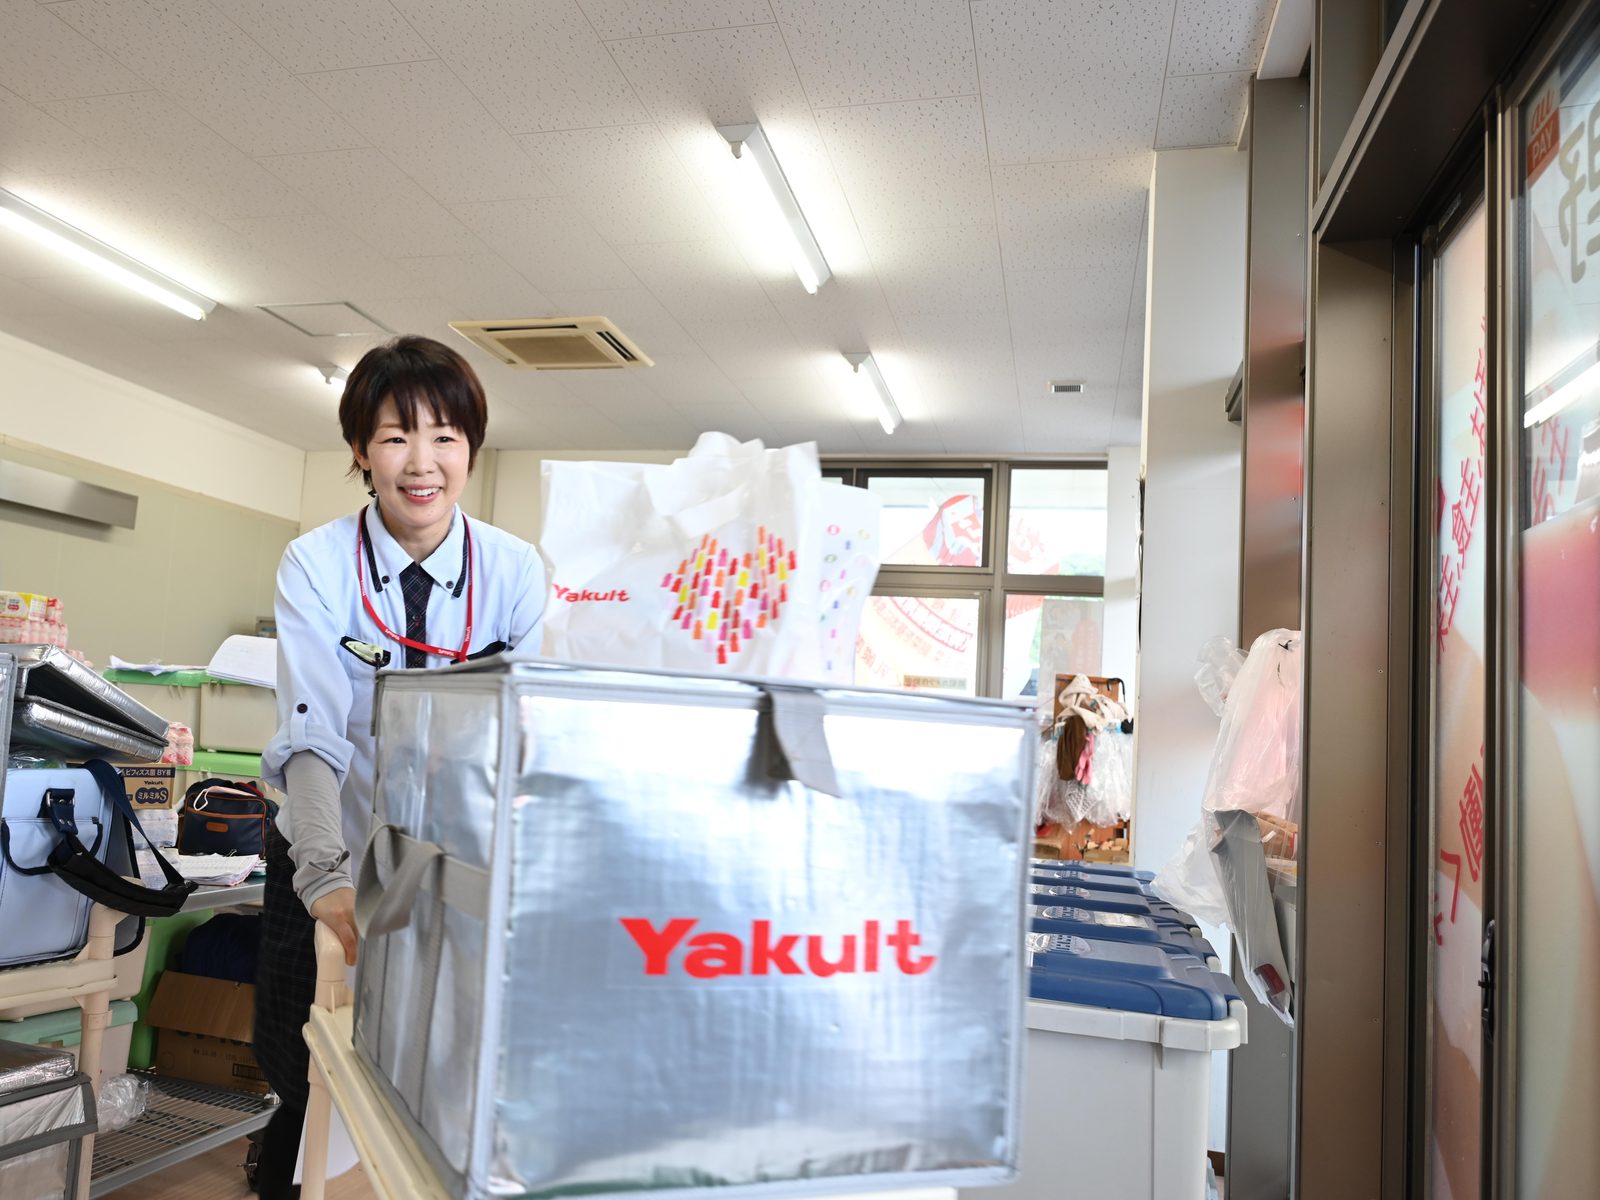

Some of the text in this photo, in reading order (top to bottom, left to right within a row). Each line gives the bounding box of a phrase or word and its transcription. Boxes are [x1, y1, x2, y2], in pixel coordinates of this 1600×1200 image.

[1532, 118, 1553, 169] PAY
[552, 583, 630, 602] Yakult
[618, 917, 938, 979] Yakult
